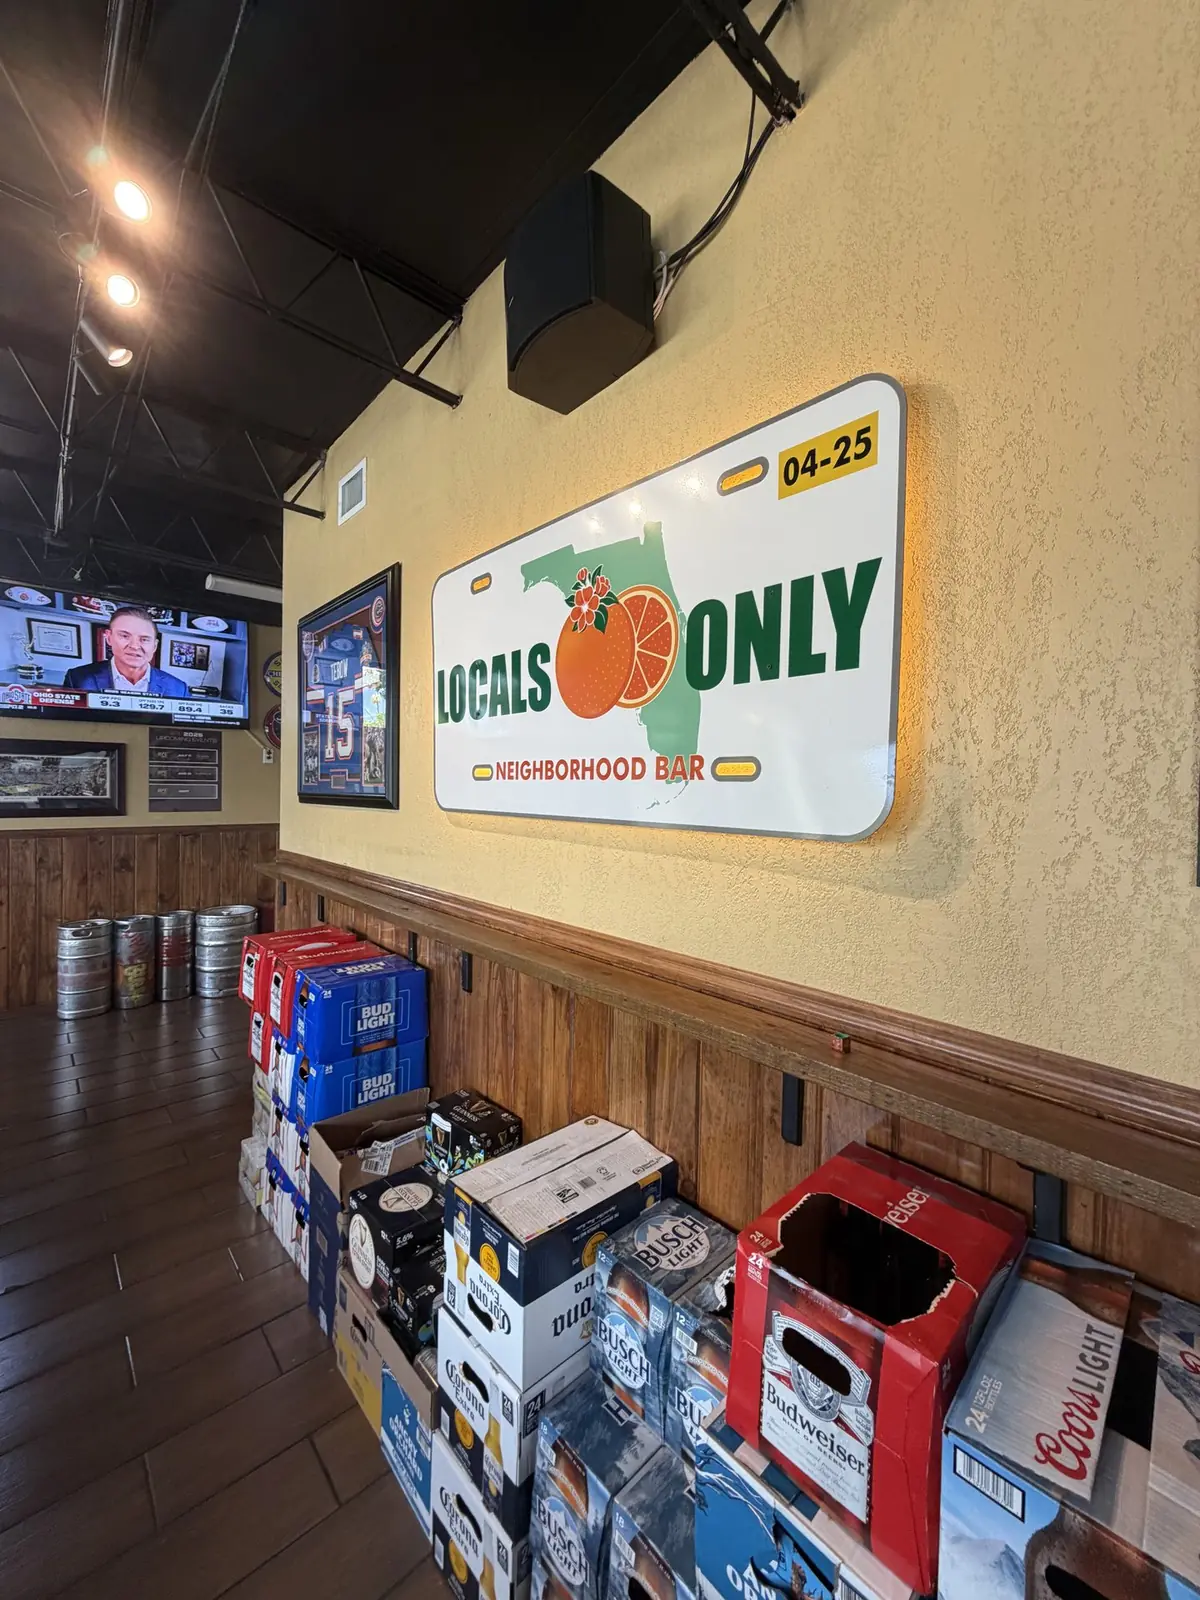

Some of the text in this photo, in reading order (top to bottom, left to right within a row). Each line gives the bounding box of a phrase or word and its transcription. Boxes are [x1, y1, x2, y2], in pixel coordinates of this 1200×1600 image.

[782, 426, 873, 487] 04-25
[437, 557, 883, 724] LOCALS ONLY
[331, 658, 349, 681] TEBOW
[55, 693, 81, 701] STATE
[325, 688, 355, 761] 15
[496, 755, 705, 782] NEIGHBORHOOD BAR
[357, 1012, 396, 1032] LIGHT
[361, 1002, 392, 1019] BUD
[358, 1083, 396, 1105] LIGHT
[362, 1073, 392, 1091] BUD
[453, 1105, 481, 1122] GUINNESS
[398, 1187, 419, 1207] GUINNESS
[883, 1187, 930, 1228] eiser
[396, 1231, 414, 1246] 5.6%
[635, 1217, 707, 1269] BUSCH
[750, 1231, 764, 1243] 24
[597, 1250, 606, 1261] 12
[667, 1237, 704, 1267] LIGHT
[748, 1253, 763, 1269] 24
[479, 1273, 500, 1306] Extra
[574, 1273, 594, 1293] tra
[470, 1277, 511, 1335] Corona
[676, 1312, 686, 1324] 12
[598, 1319, 650, 1382] BUSCH
[608, 1351, 638, 1384] LIGHT
[446, 1359, 485, 1420] Corona
[984, 1379, 1003, 1411] BOTTLES
[1034, 1324, 1116, 1480] Coors LIGHT
[453, 1385, 475, 1422] Extra
[503, 1395, 512, 1411] 24
[527, 1394, 541, 1419] 24
[540, 1422, 548, 1435] 18
[767, 1382, 865, 1477] Budweiser
[965, 1407, 989, 1433] 24
[440, 1487, 479, 1558] Corona
[615, 1512, 625, 1528] 18
[449, 1516, 469, 1556] Extra
[538, 1498, 588, 1583] BUSCH
[498, 1541, 508, 1559] 24
[521, 1544, 529, 1565] 2
[547, 1535, 578, 1578] LIGHT
